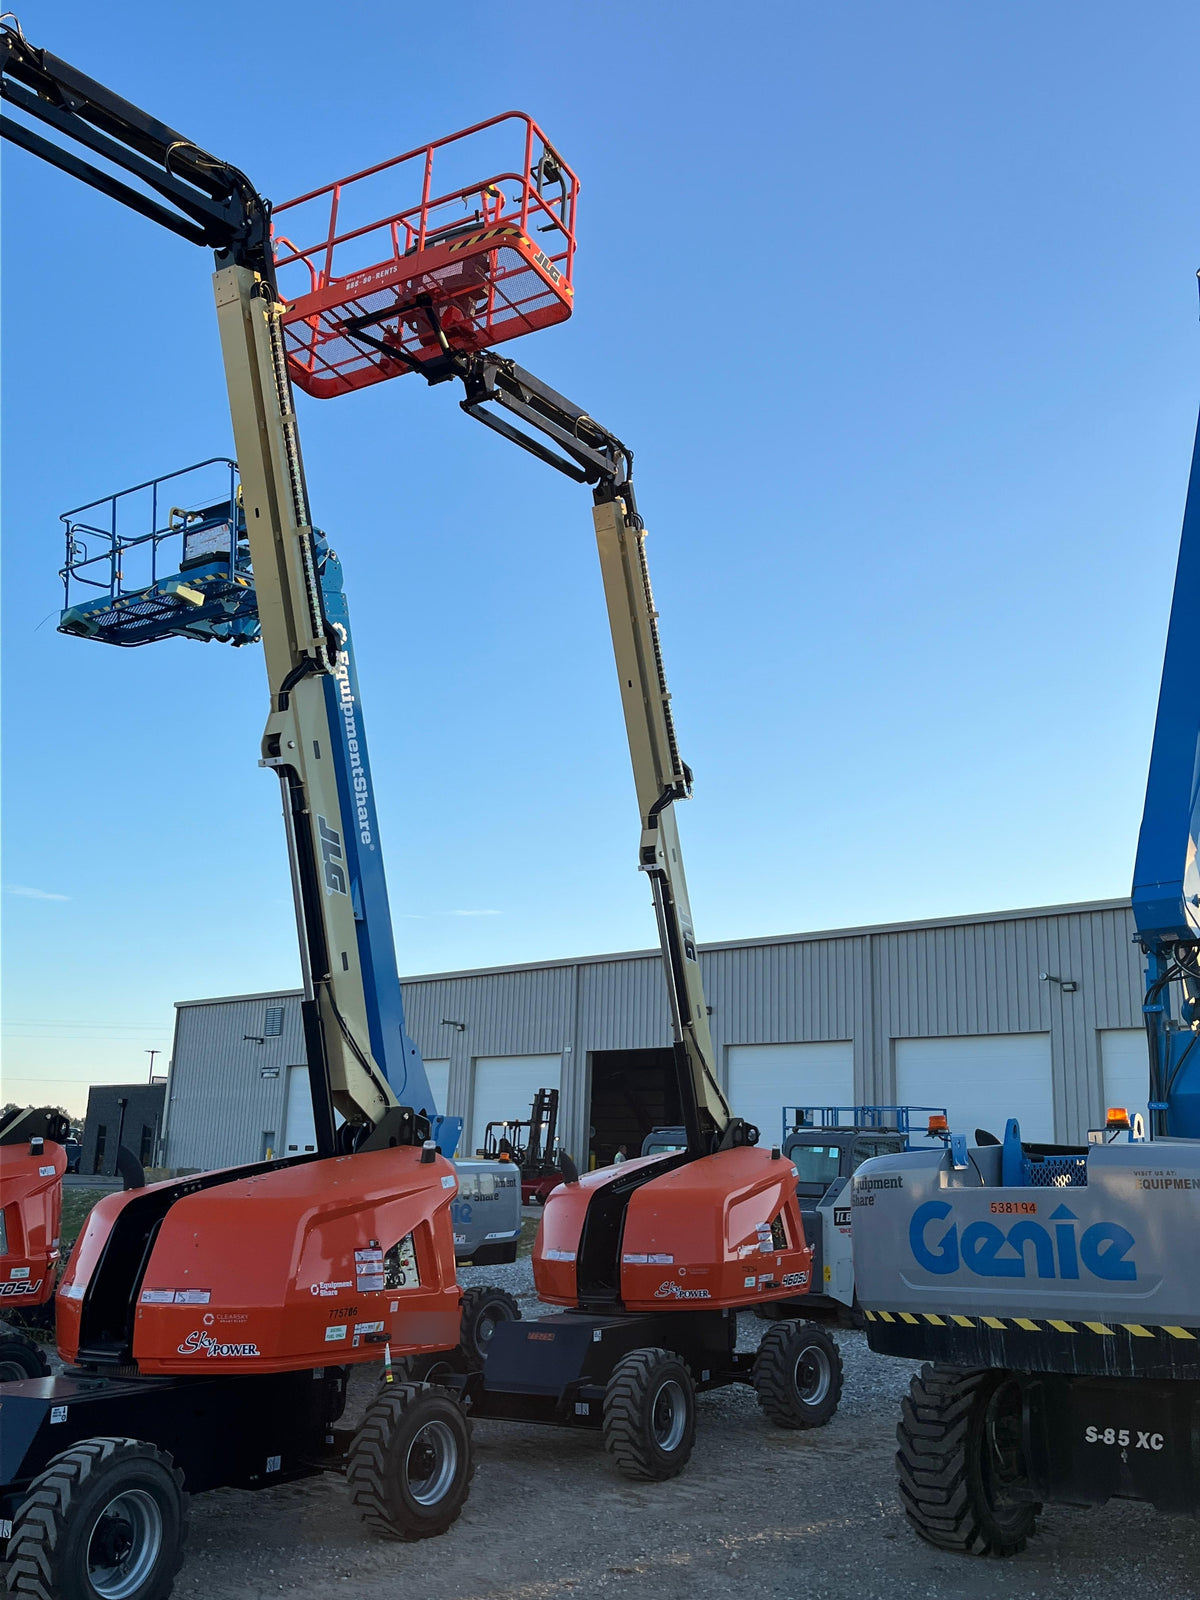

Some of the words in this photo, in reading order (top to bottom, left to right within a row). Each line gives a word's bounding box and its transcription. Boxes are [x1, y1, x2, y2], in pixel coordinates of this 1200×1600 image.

[533, 251, 561, 284] JLG
[317, 814, 347, 896] JLG
[990, 1202, 1037, 1214] 538194
[909, 1200, 1138, 1282] Genie
[319, 1280, 353, 1290] Equipment
[319, 1289, 338, 1297] Share
[1085, 1425, 1130, 1446] S-85
[1135, 1431, 1164, 1451] XC
